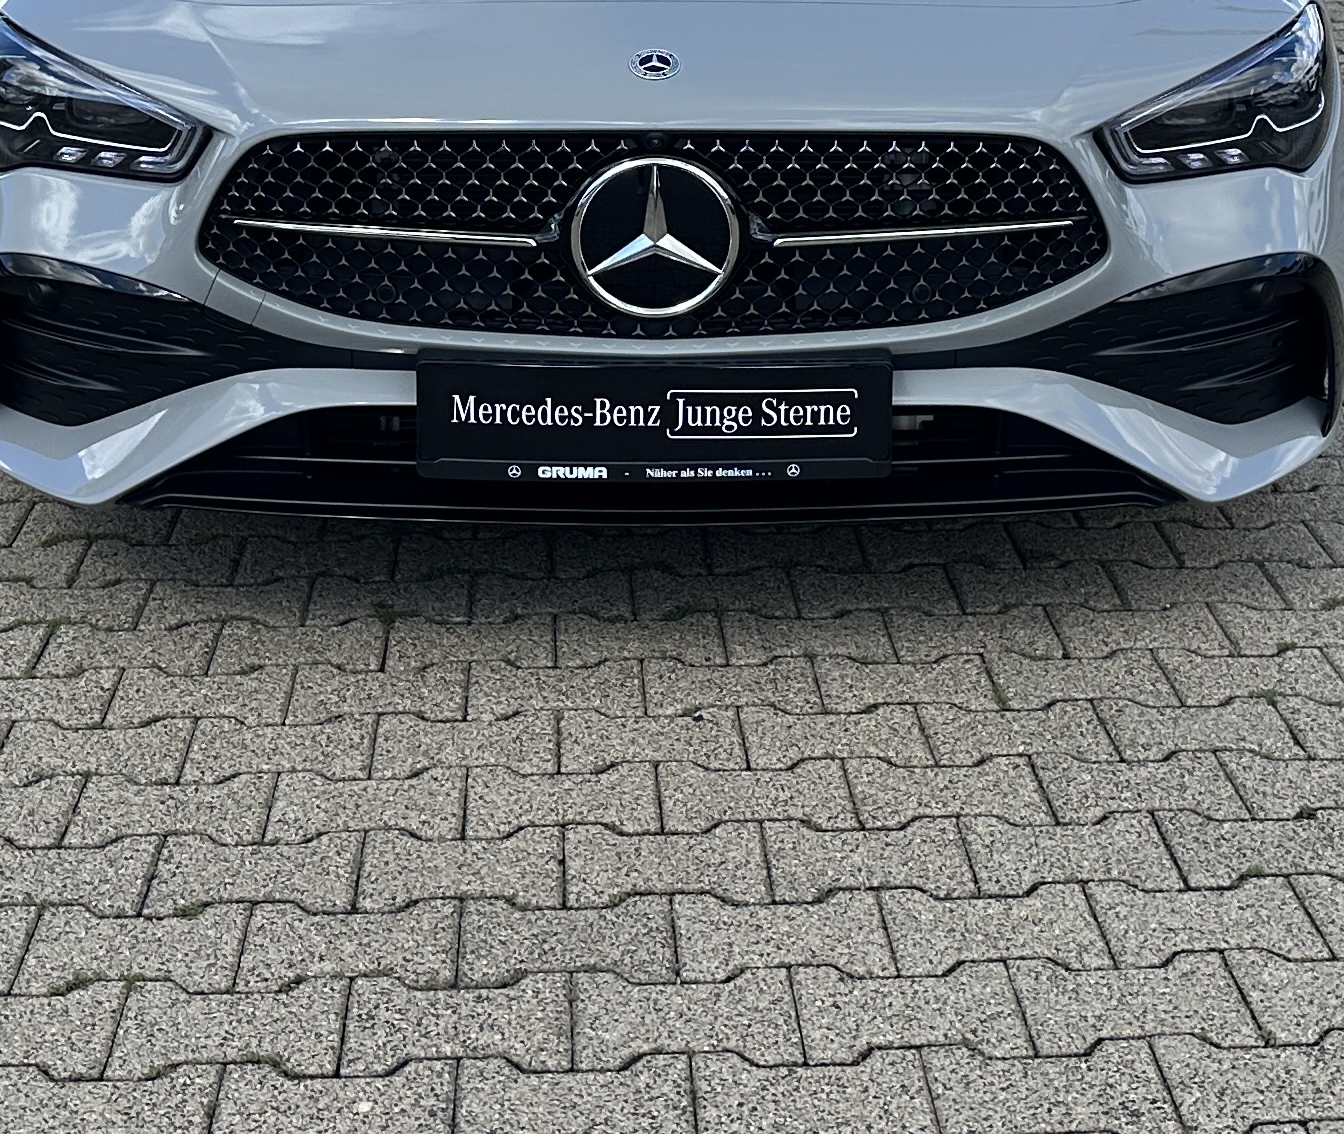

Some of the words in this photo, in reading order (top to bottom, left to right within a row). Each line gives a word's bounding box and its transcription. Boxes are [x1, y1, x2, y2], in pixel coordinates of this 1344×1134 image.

[451, 394, 661, 427] Mercedes-Benz
[674, 398, 753, 433] Junge
[761, 397, 851, 427] Sterne
[537, 466, 608, 479] GRUMA
[645, 468, 678, 478] Näher
[680, 467, 695, 478] als
[697, 467, 713, 477] Sie
[715, 467, 753, 477] denken
